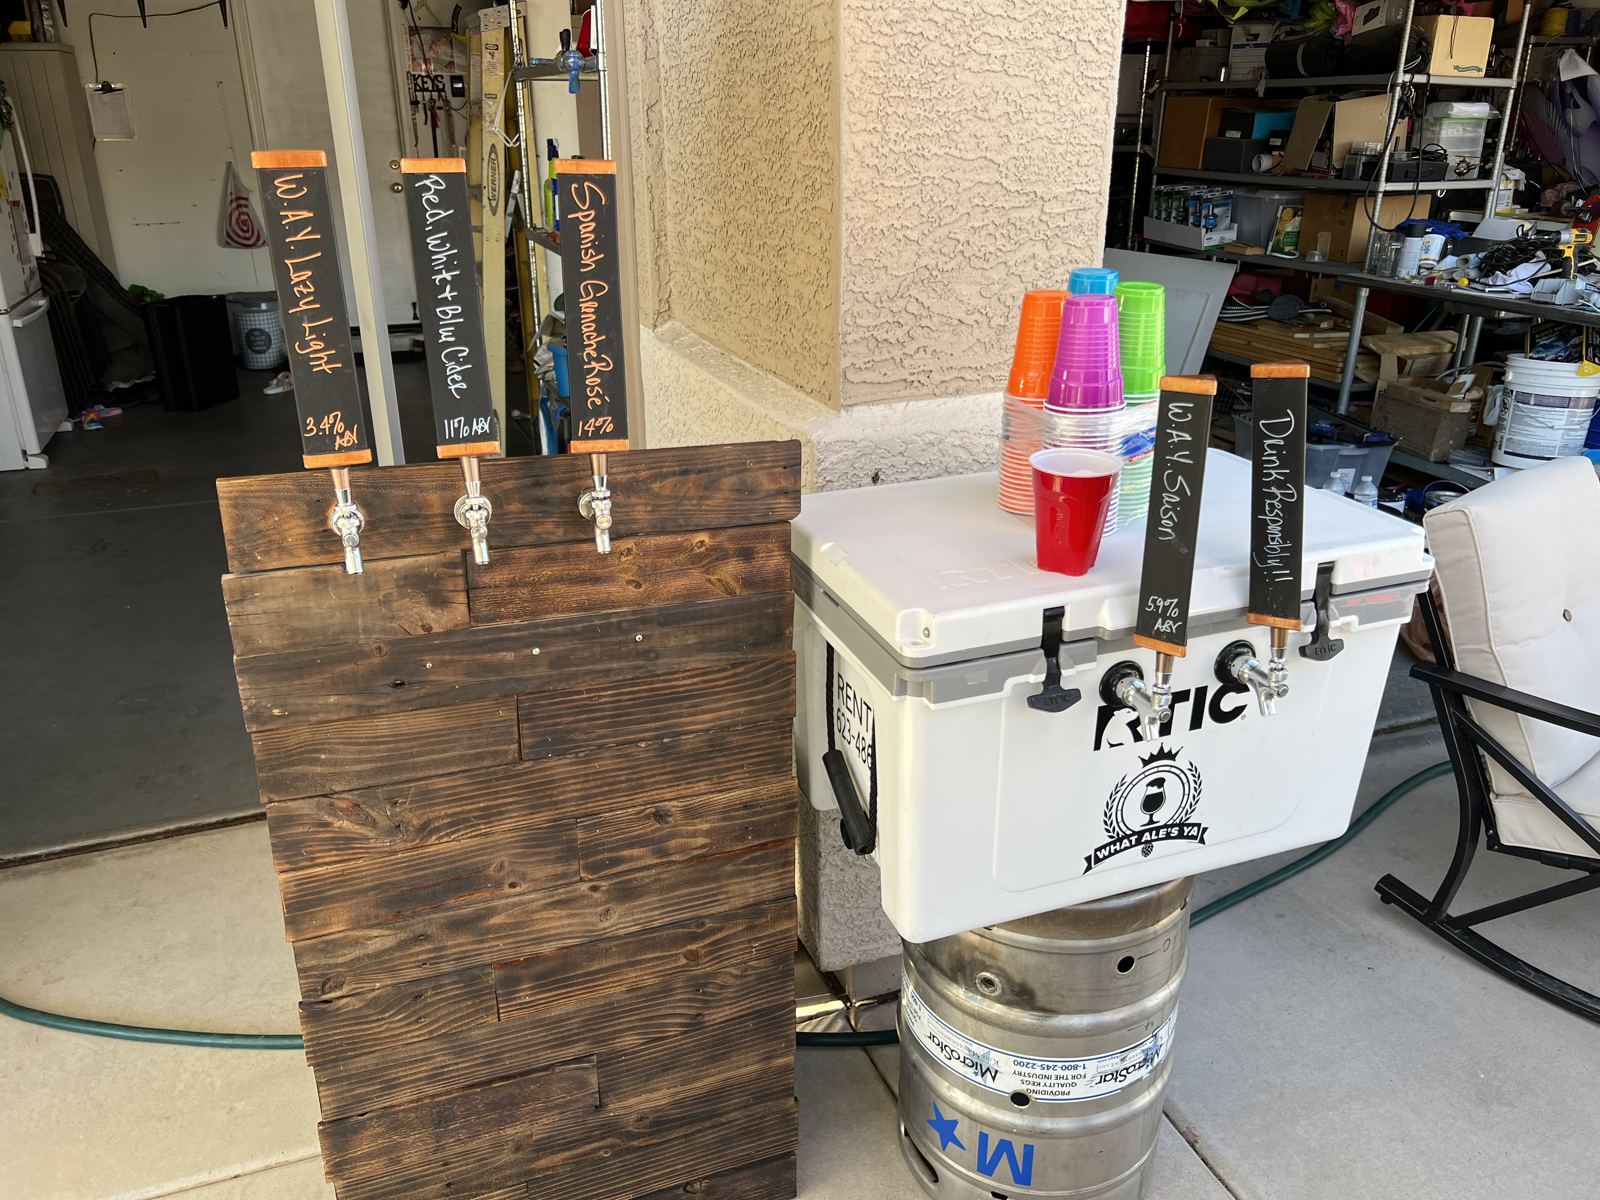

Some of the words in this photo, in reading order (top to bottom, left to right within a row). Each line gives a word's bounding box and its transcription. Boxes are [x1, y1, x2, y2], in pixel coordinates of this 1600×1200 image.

[414, 74, 446, 92] KEYS
[567, 181, 606, 273] Spanish
[285, 251, 322, 314] Lazy
[579, 280, 609, 356] Grenache
[295, 316, 342, 374] Light
[440, 347, 472, 398] Cider
[304, 411, 345, 437] 3.4%
[335, 423, 358, 450] ABV
[444, 416, 470, 439] 11%
[471, 416, 491, 436] ABV
[577, 416, 614, 437] 14%
[1259, 409, 1295, 481] Drink
[1158, 469, 1191, 541] Saison
[1145, 596, 1179, 618] 5.9%
[1154, 618, 1183, 634] ABV
[838, 672, 872, 733] RENT
[1096, 836, 1138, 859] WHAT
[1141, 826, 1179, 842] ALE'S
[1184, 826, 1199, 837] YA
[926, 1031, 999, 1083] MicroStar
[1012, 1059, 1087, 1071] 1-800-245-2200
[1012, 1070, 1052, 1080] INDUSTRY
[1020, 1079, 1041, 1087] KEGS
[1026, 1088, 1071, 1096] PROVIDING
[976, 1130, 1035, 1187] M
